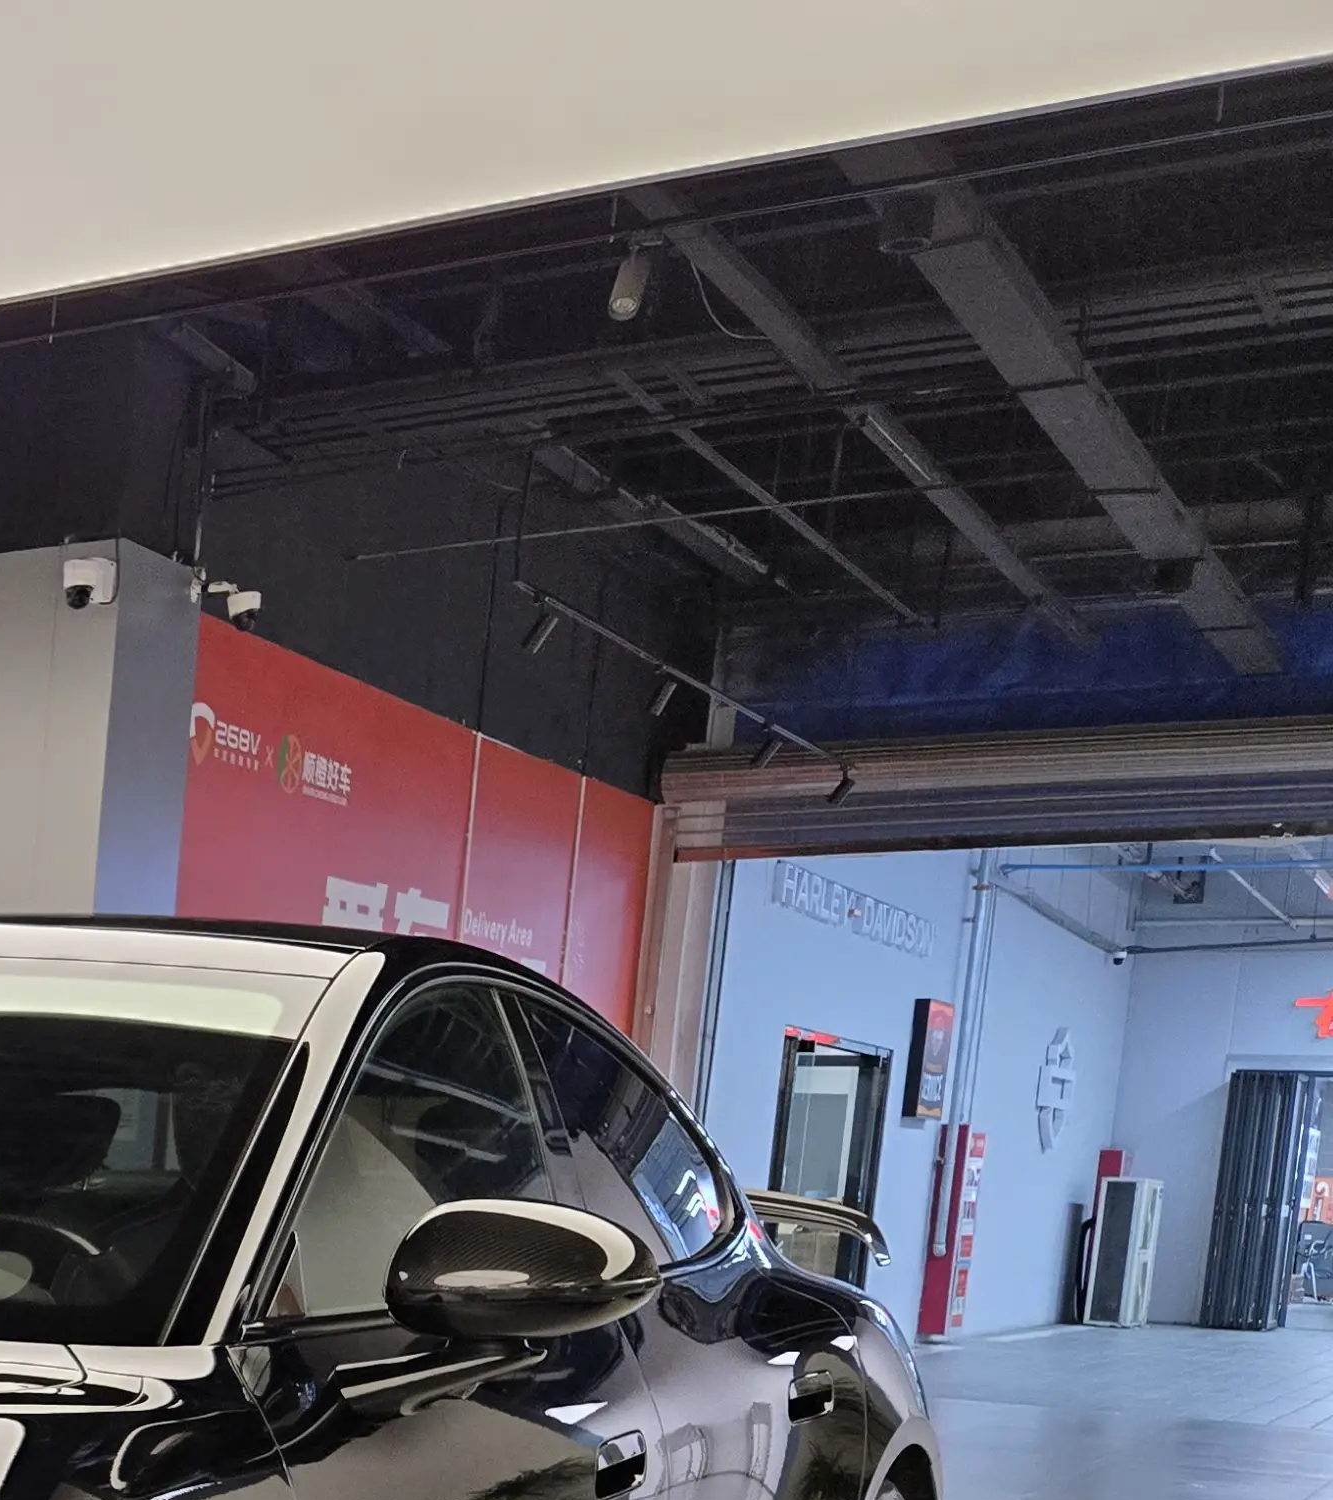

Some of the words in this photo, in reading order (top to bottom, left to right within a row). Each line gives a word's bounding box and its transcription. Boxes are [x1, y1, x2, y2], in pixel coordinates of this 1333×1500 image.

[302, 751, 352, 795] 顺橙好车
[464, 908, 508, 948] Delivery
[508, 917, 534, 949] Area
